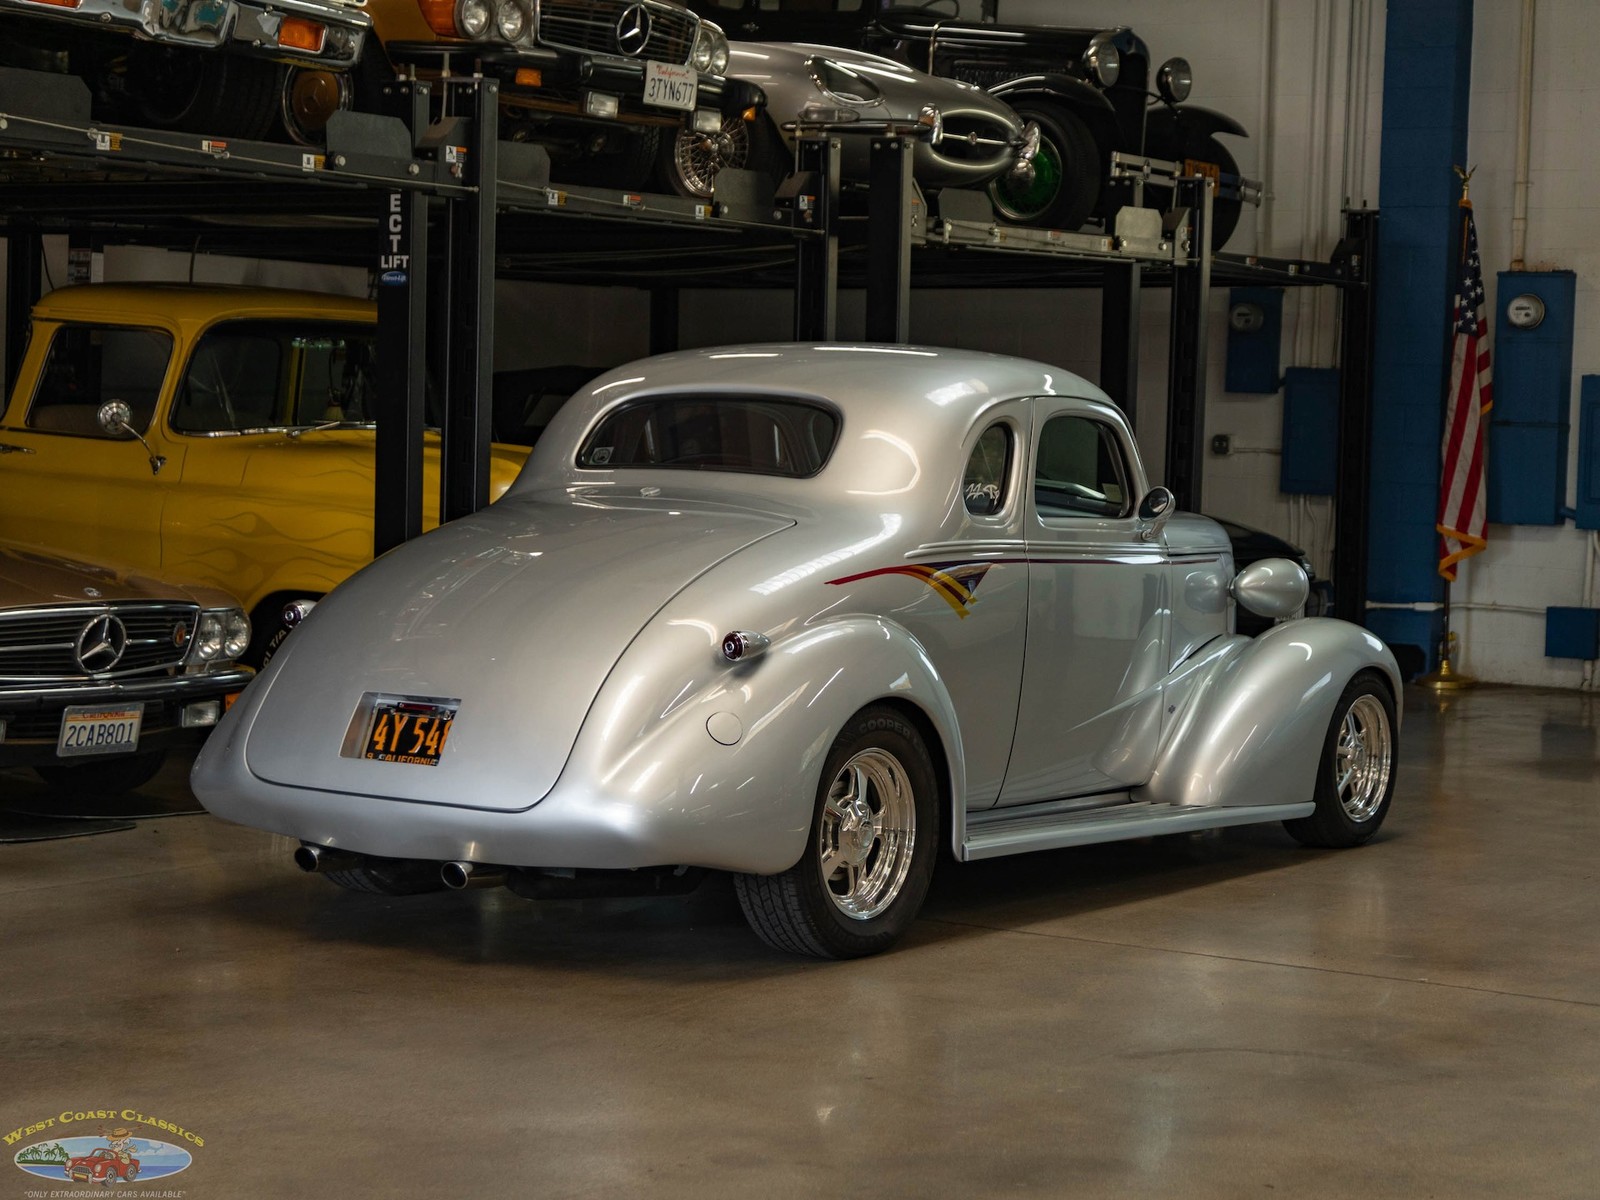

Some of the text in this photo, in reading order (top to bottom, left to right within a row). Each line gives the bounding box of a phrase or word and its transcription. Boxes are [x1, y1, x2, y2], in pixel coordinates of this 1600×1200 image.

[649, 78, 694, 103] 3TYN677
[381, 255, 409, 269] LIFT
[65, 722, 134, 747] 2CAB801
[374, 714, 409, 752] 4Y
[859, 719, 911, 738] COOPER
